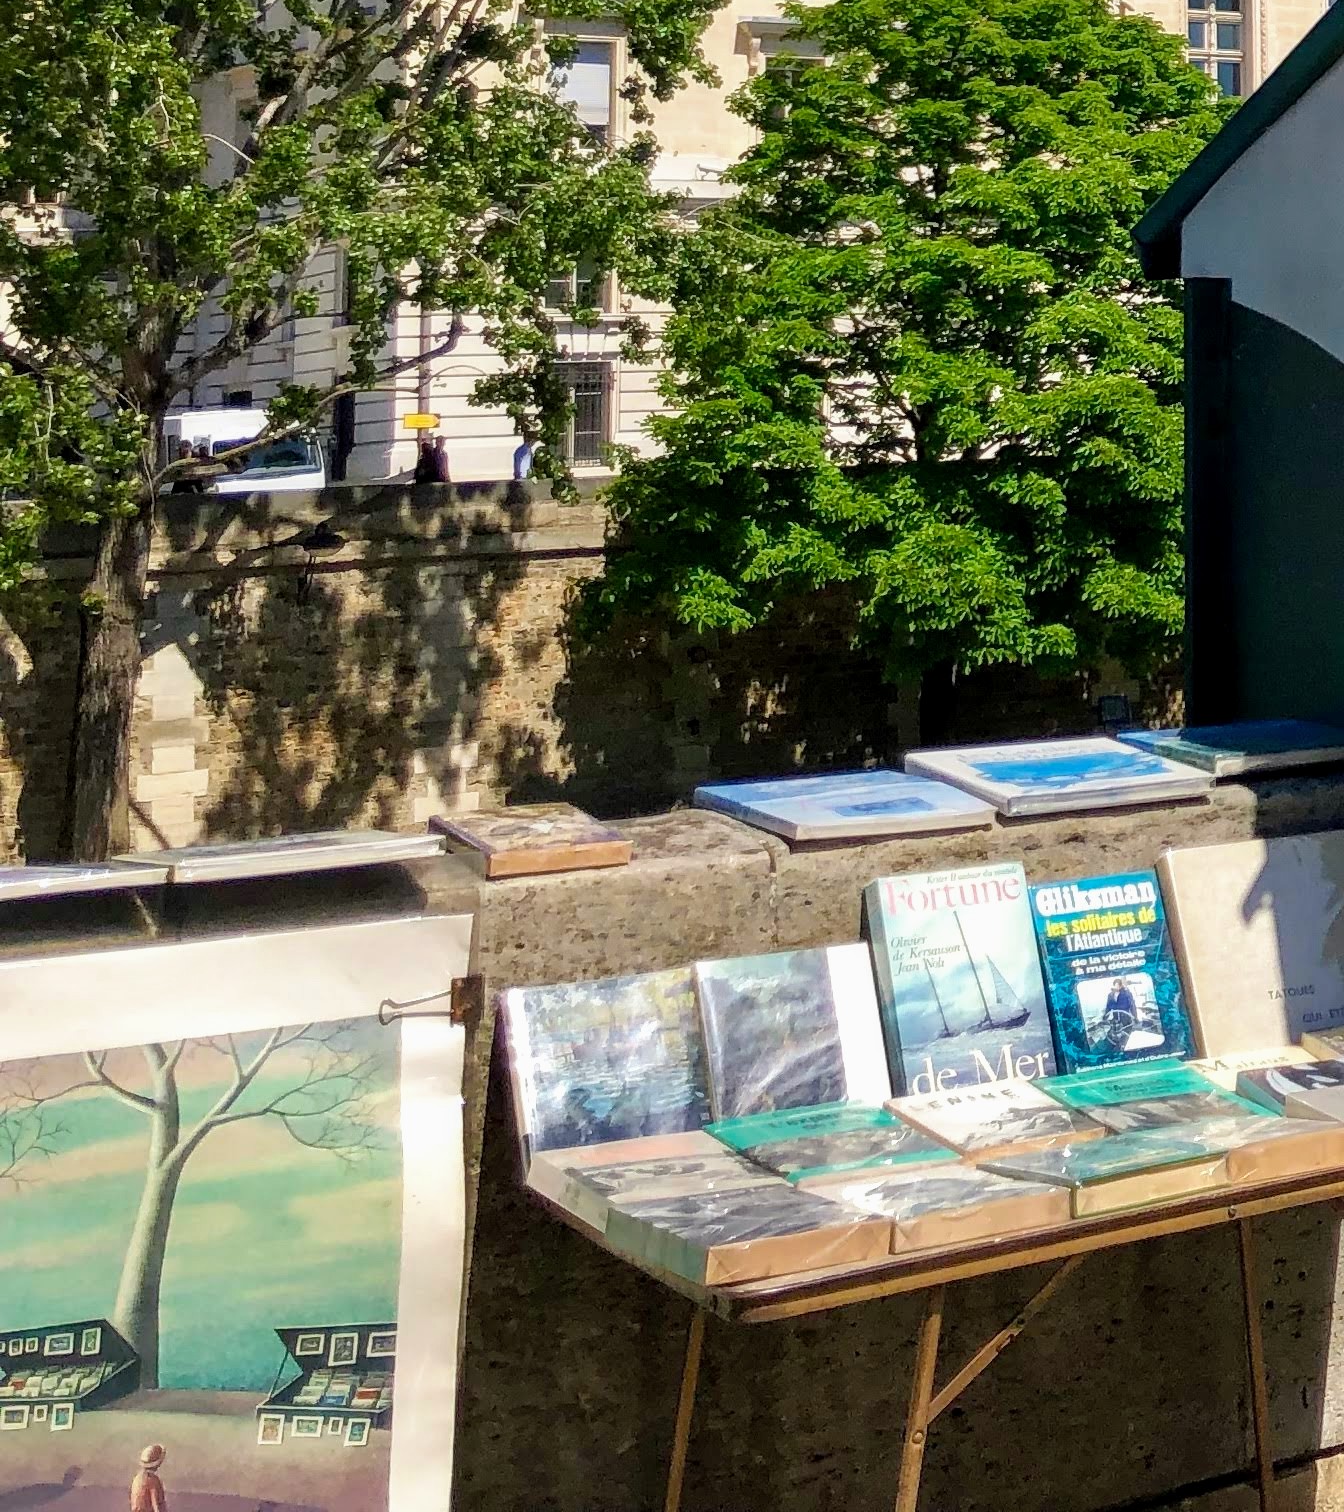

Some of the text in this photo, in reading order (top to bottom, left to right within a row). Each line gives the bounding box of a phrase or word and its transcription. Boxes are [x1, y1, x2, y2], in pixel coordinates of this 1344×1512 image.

[885, 877, 1022, 916] Fortune
[1035, 881, 1158, 917] Gliksman
[1046, 906, 1156, 937] les solitaires de
[1065, 927, 1143, 953] l'Atlantique
[892, 951, 903, 961] de
[1071, 949, 1146, 968] de la victoire
[894, 959, 920, 976] Jean
[1086, 963, 1107, 975] ma
[1302, 1012, 1323, 1023] QUI
[911, 1044, 1049, 1096] de Mer
